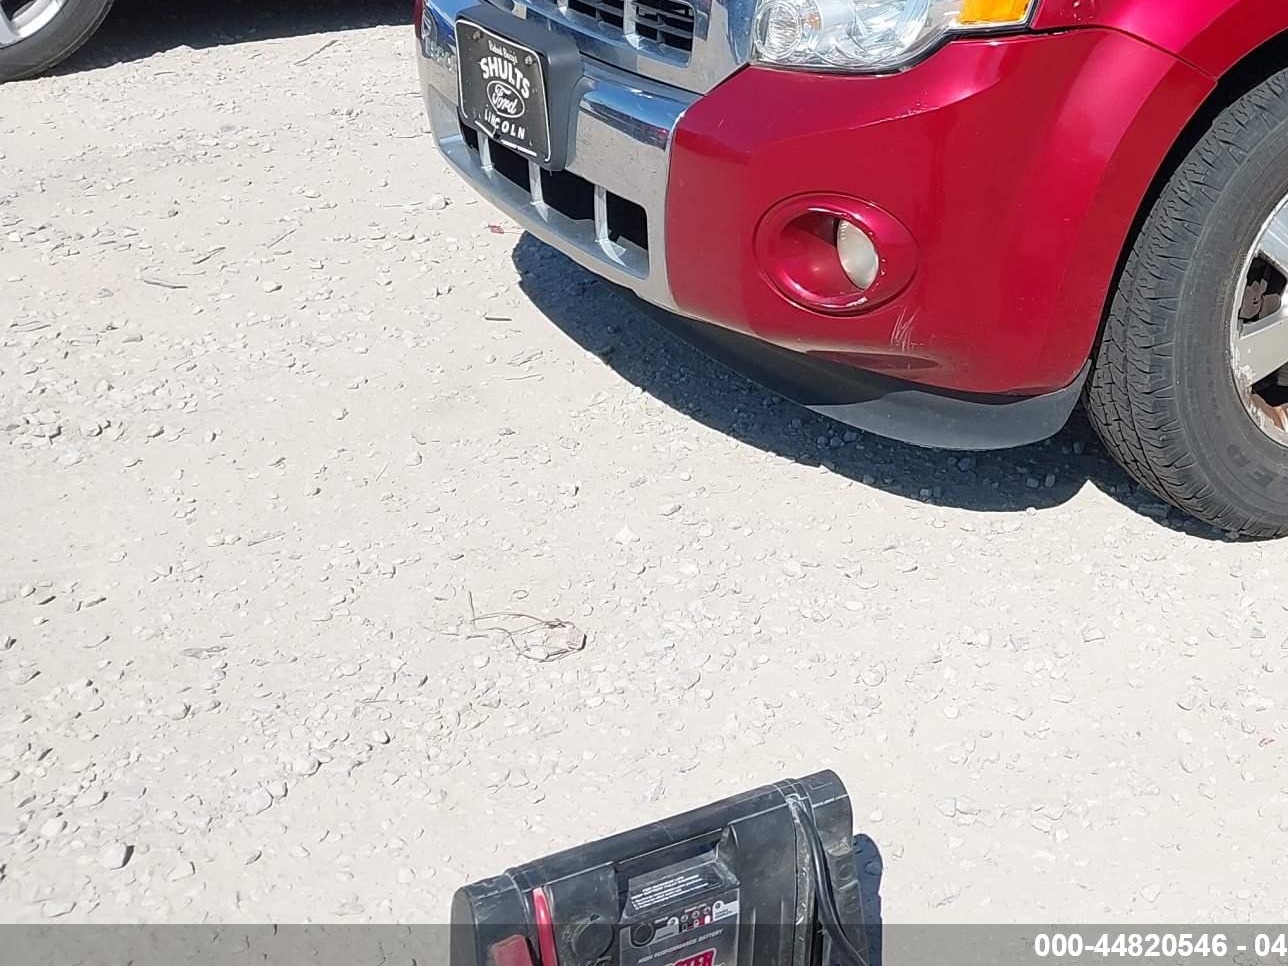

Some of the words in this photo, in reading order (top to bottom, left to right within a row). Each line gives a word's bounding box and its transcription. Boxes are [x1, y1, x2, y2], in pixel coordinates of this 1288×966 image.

[480, 56, 531, 99] SHULTS
[491, 83, 519, 115] Ford
[484, 108, 526, 141] LINCOLN
